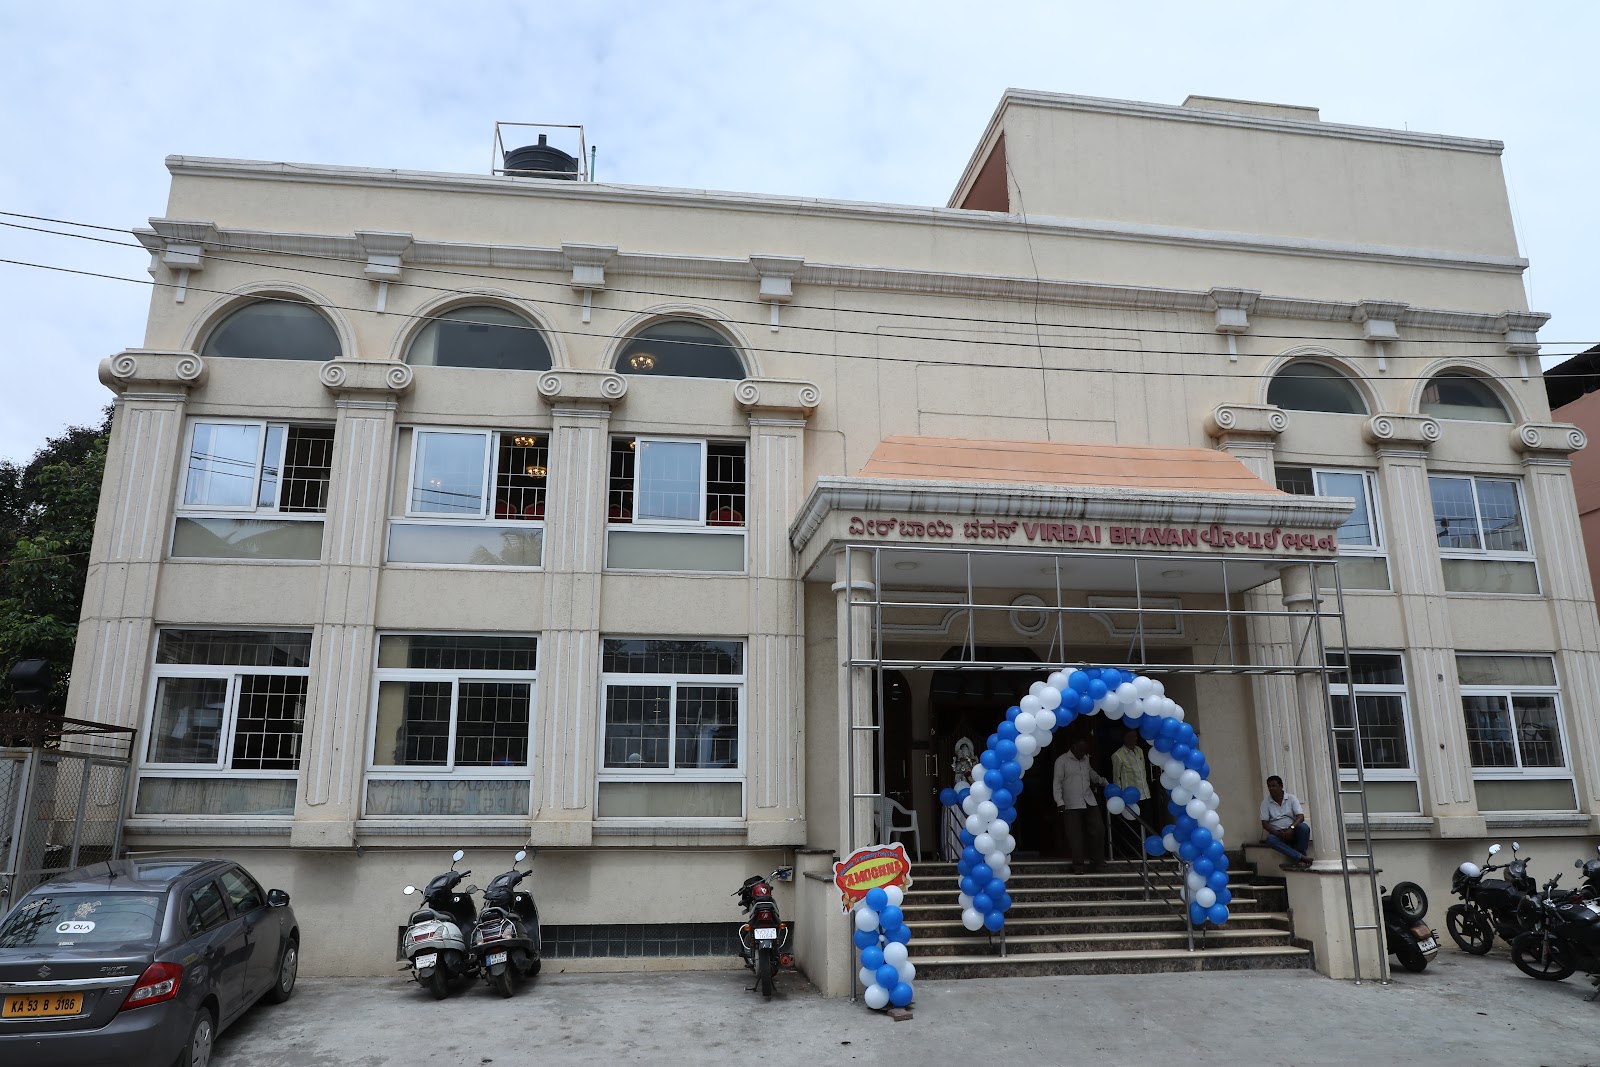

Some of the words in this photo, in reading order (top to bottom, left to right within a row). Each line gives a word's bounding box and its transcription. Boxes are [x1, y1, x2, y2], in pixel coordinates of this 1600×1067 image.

[1022, 521, 1102, 543] VIRBAI
[1109, 526, 1199, 546] BHAVAN
[11, 1001, 24, 1013] KA
[27, 1000, 39, 1012] 53
[43, 999, 50, 1011] B
[55, 999, 75, 1011] 3186
